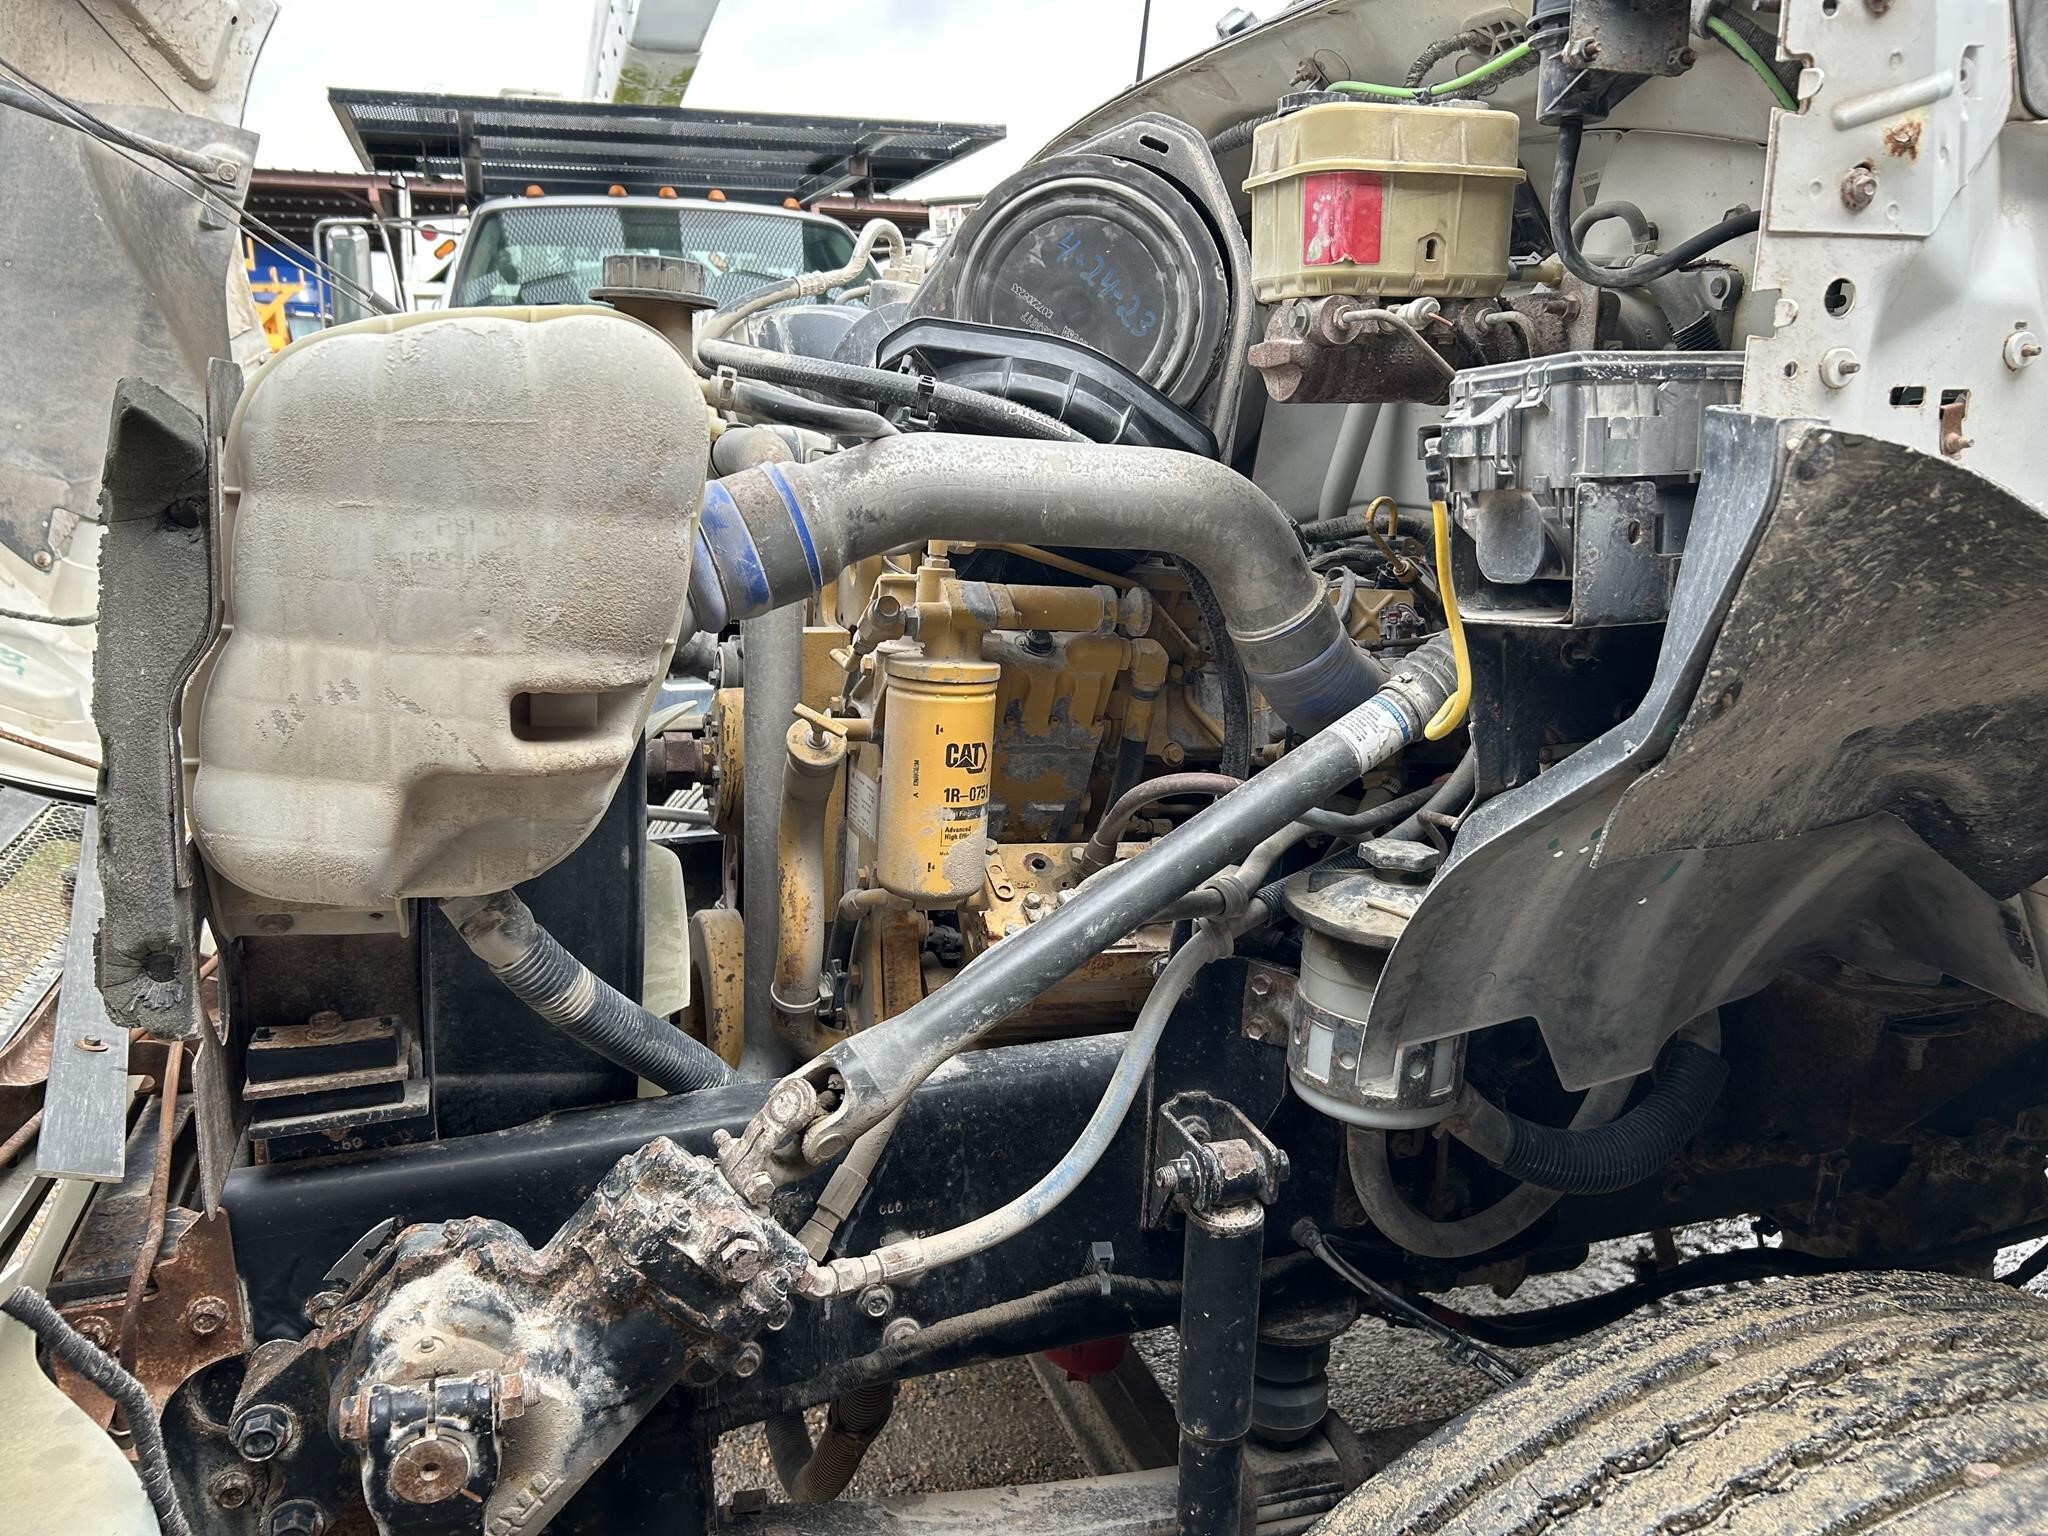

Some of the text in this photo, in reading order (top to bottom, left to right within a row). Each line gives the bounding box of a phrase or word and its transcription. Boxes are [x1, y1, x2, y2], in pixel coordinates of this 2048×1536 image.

[1056, 227, 1157, 337] 4-24-23
[945, 743, 982, 769] CAT
[945, 825, 971, 833] Advanced
[945, 833, 958, 841] High
